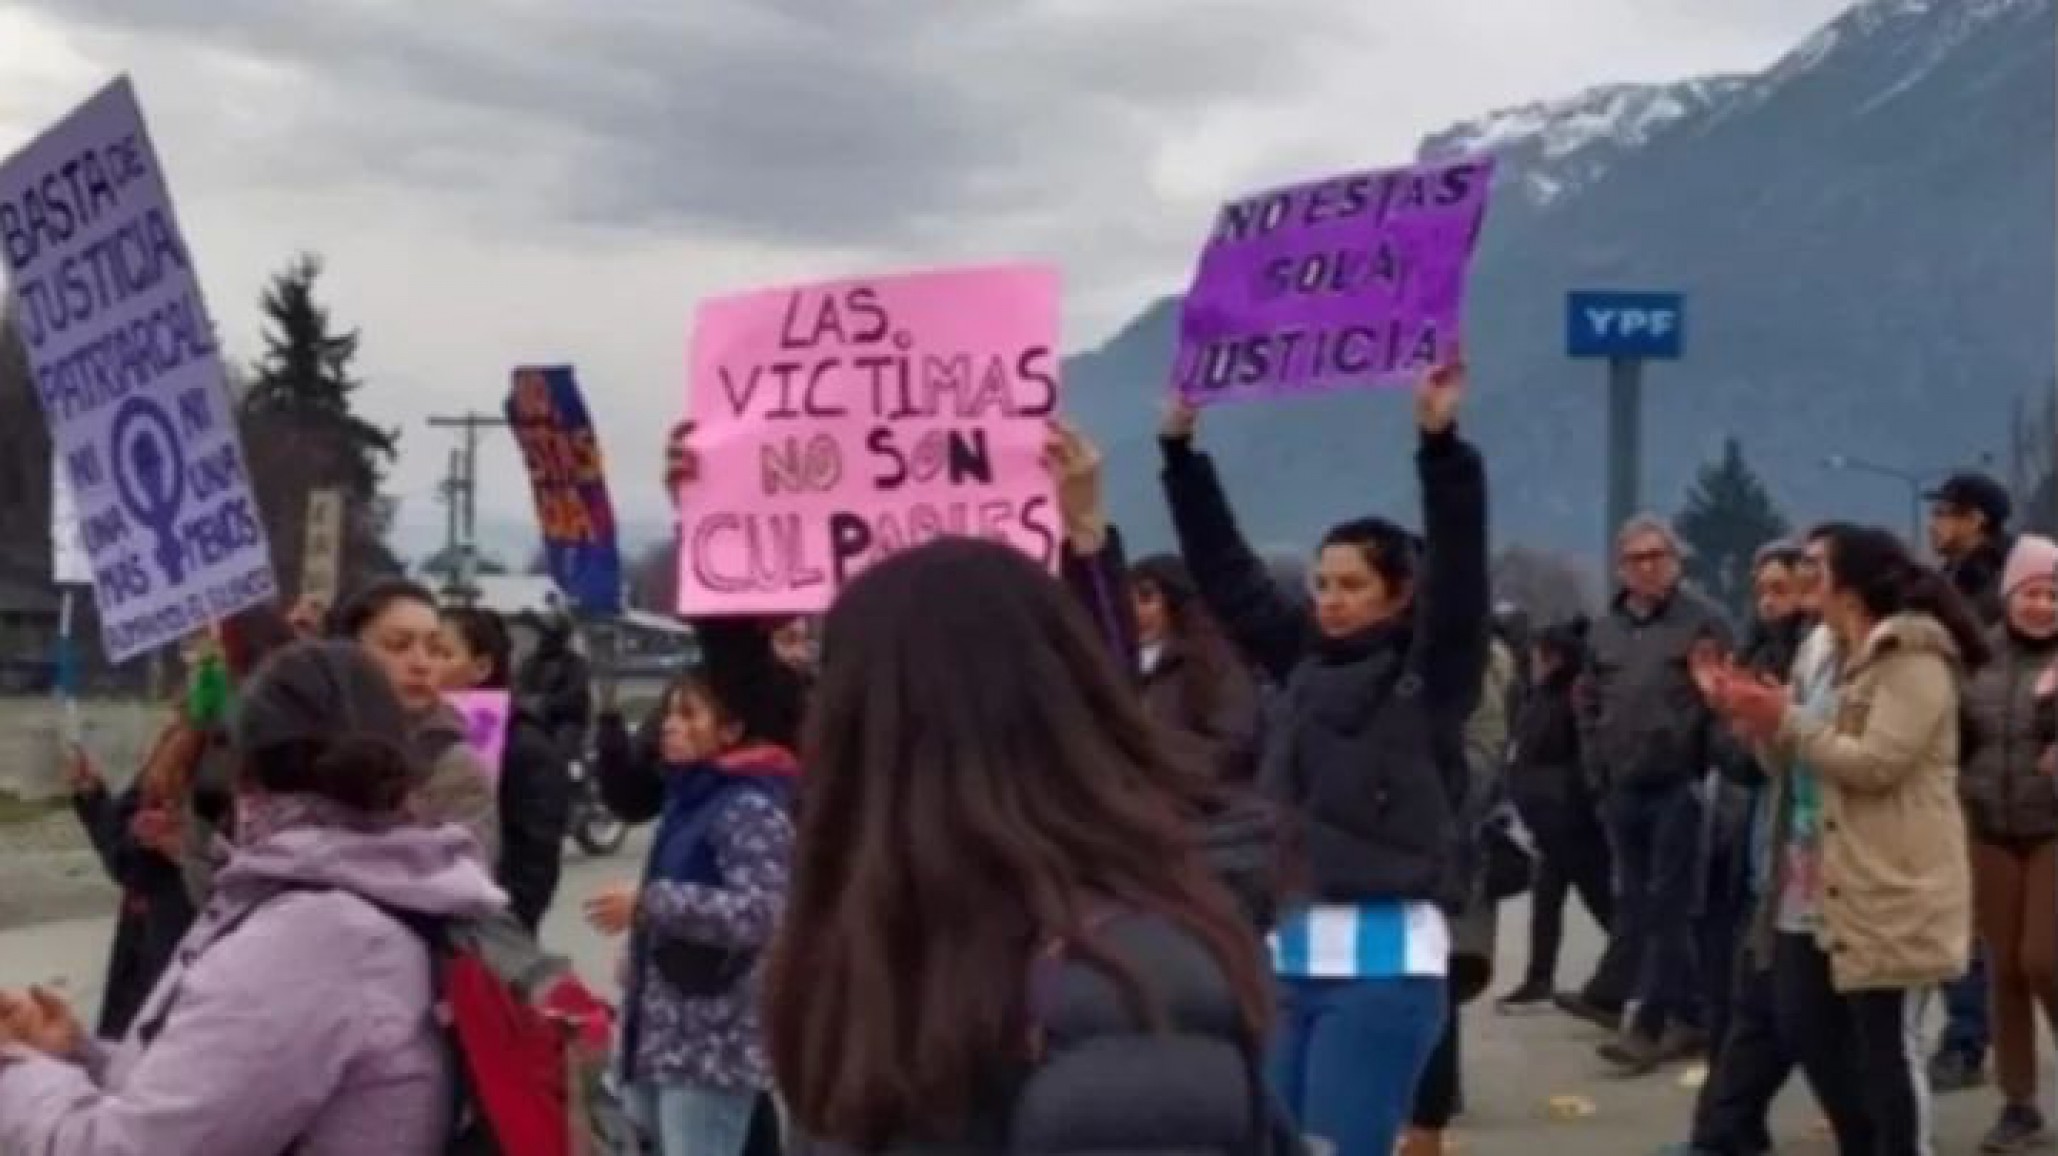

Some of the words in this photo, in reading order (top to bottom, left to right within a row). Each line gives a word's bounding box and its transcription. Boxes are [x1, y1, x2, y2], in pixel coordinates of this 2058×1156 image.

[1, 148, 119, 269] BASTA
[106, 134, 147, 187] DE
[1216, 193, 1291, 243] NO
[19, 207, 187, 347] JUSTICIA
[1584, 308, 1676, 337] YPF
[38, 292, 217, 419] PATRIARCAL
[760, 433, 842, 496] NO
[866, 427, 993, 489] SON
